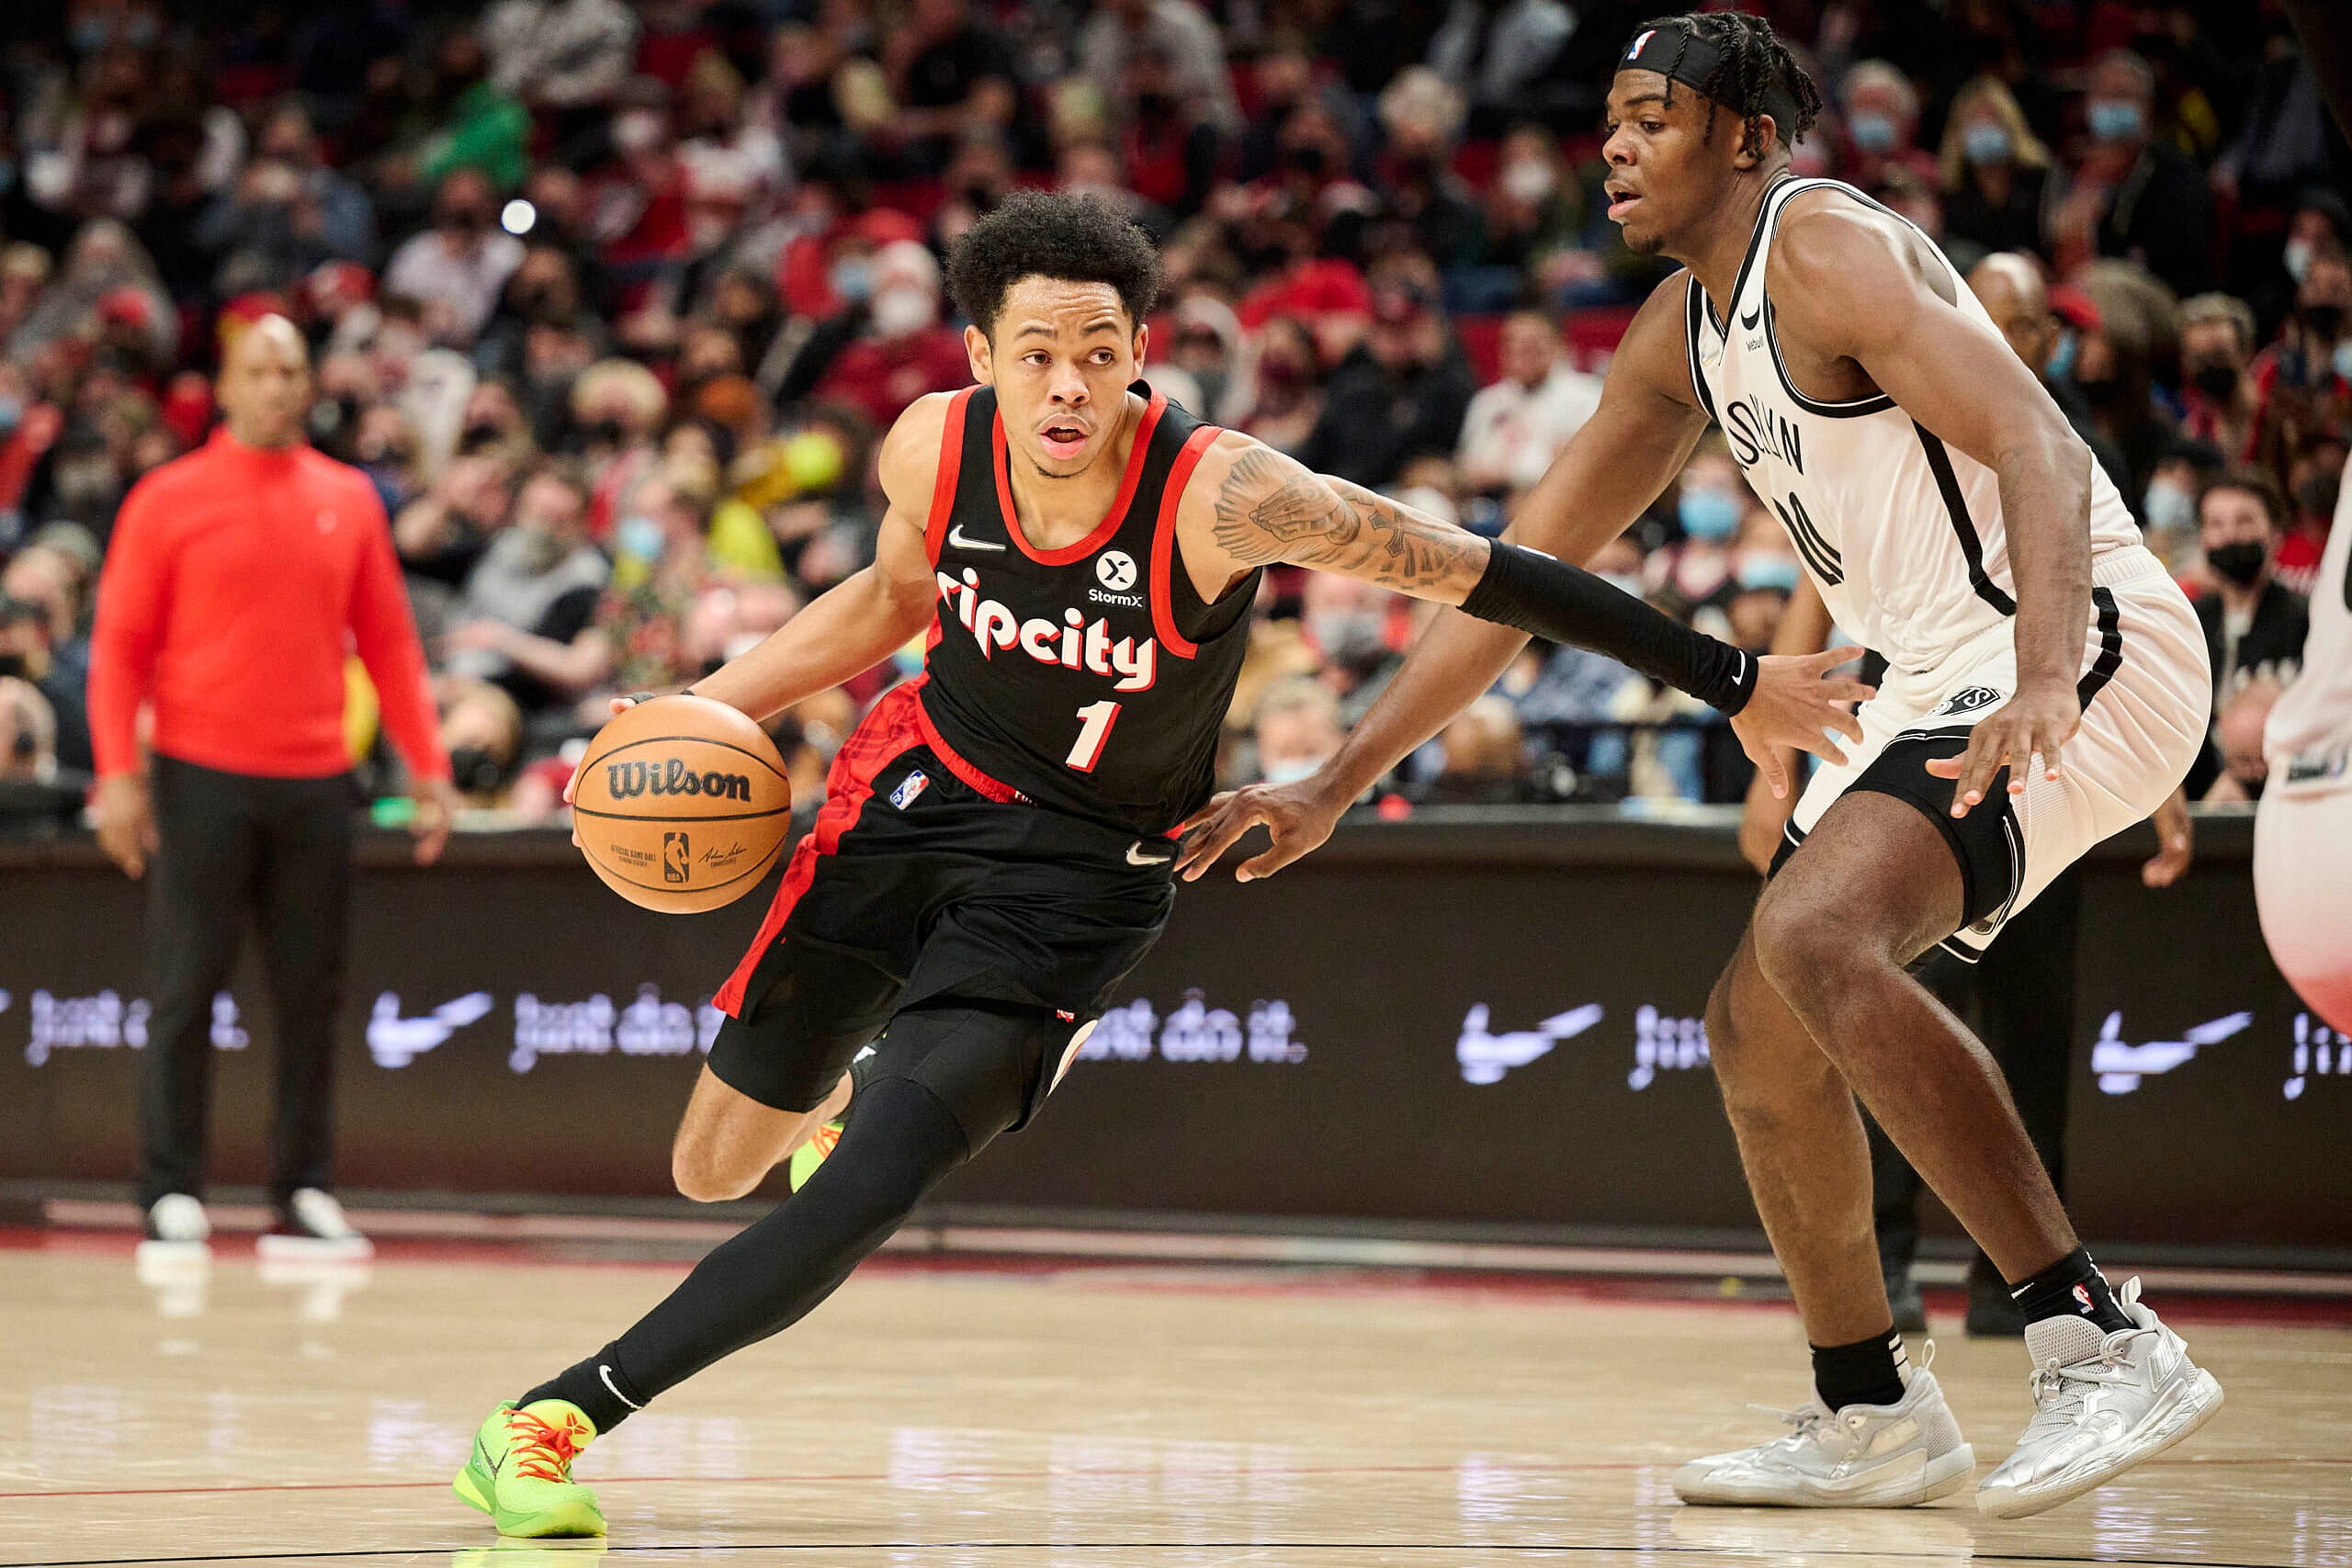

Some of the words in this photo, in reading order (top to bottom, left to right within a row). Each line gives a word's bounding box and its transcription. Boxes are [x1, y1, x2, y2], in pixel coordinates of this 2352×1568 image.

[1088, 588, 1144, 608] StormX
[1065, 700, 1123, 773] 1
[606, 756, 752, 803] Wilson
